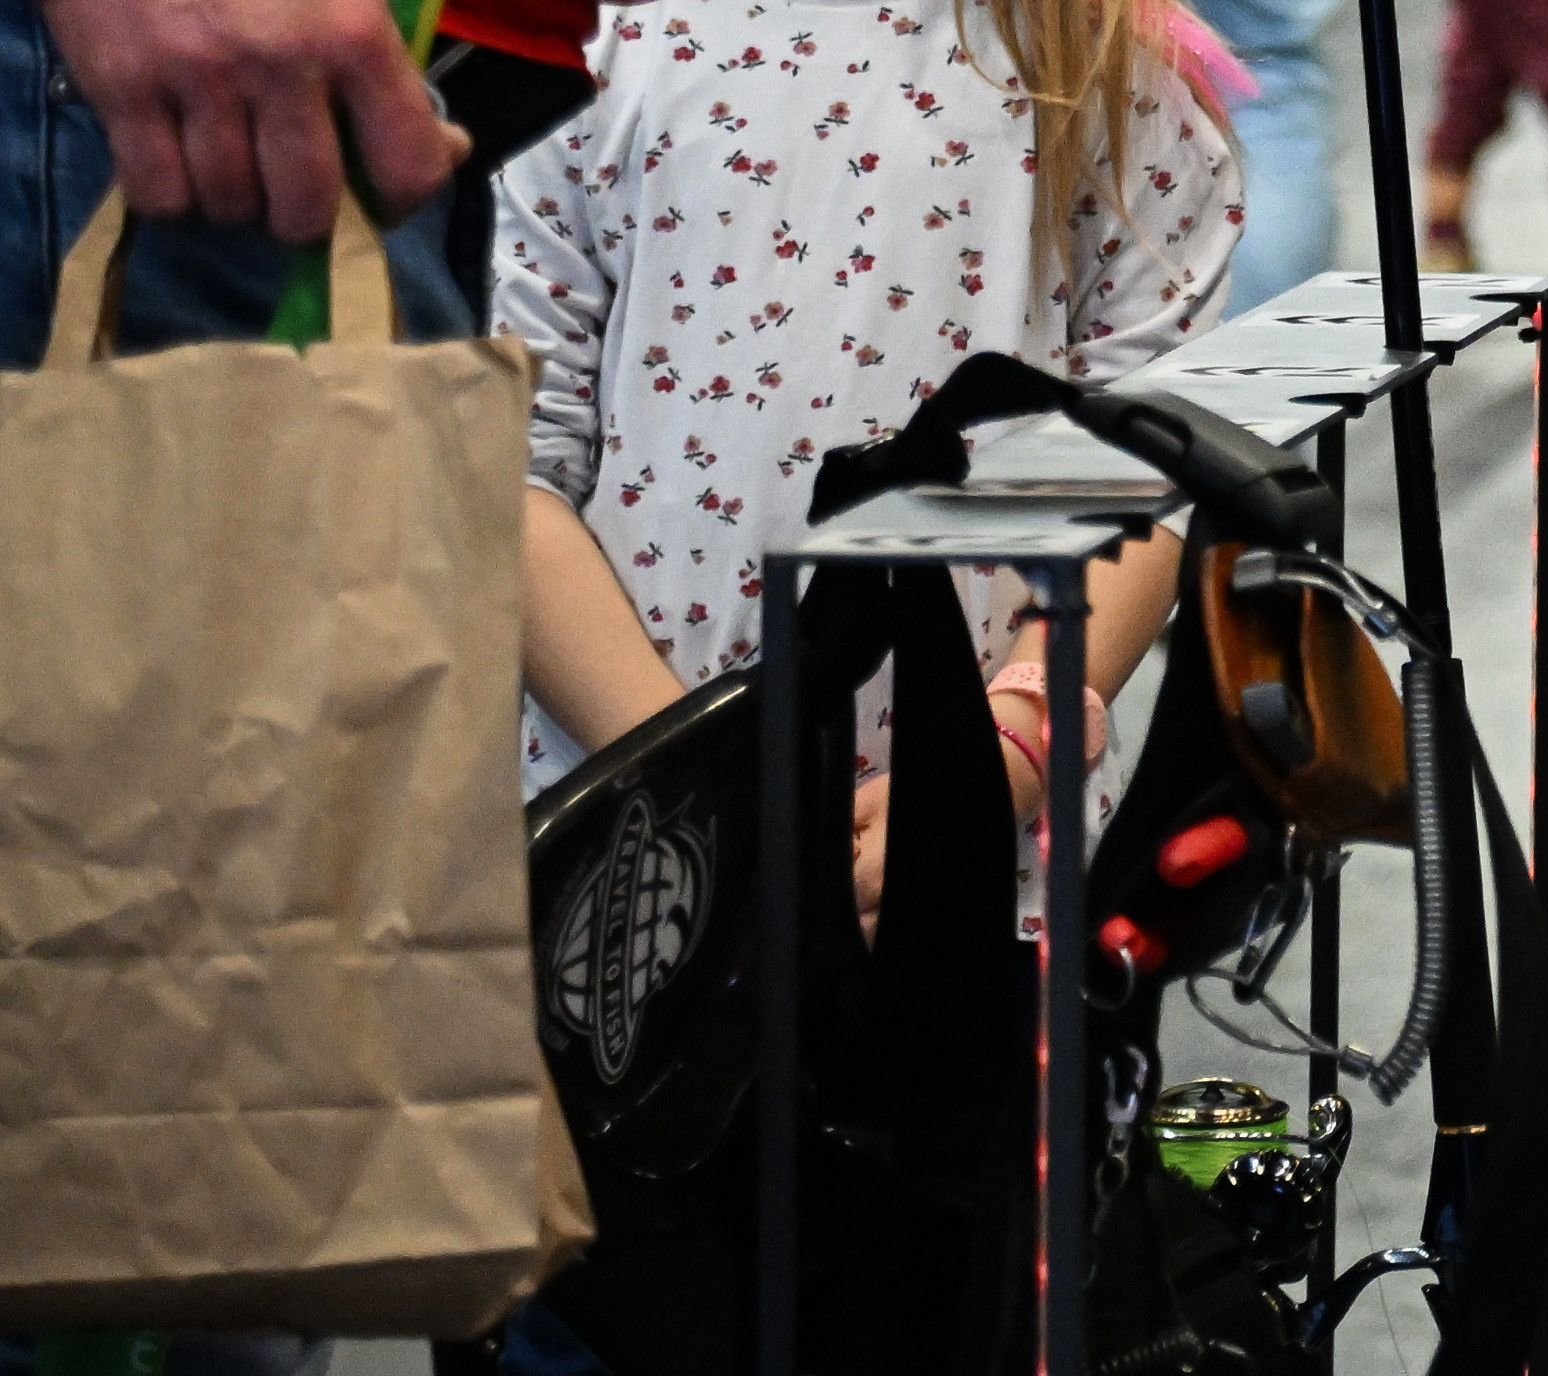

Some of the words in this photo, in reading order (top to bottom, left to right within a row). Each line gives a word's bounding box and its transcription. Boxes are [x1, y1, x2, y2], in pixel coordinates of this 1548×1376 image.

[608, 821, 644, 936] TRAVEL
[604, 946, 627, 982] TO
[604, 988, 629, 1056] FISH
